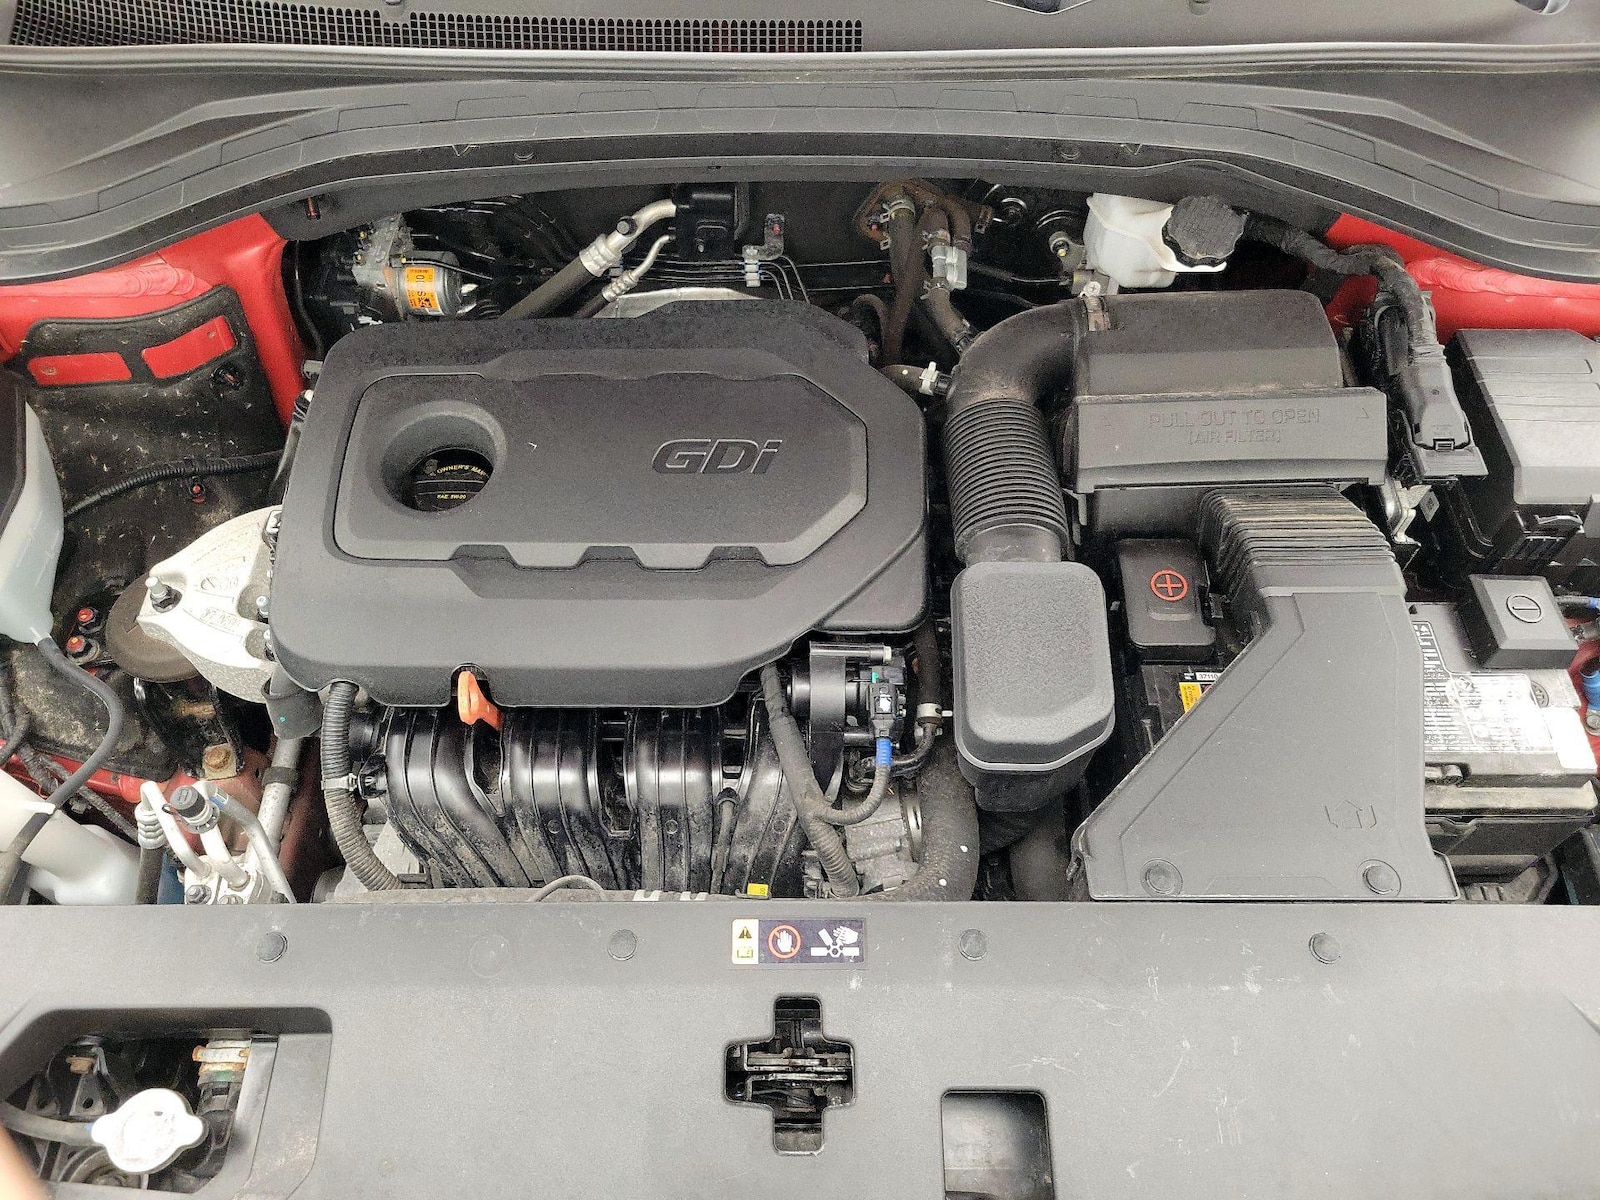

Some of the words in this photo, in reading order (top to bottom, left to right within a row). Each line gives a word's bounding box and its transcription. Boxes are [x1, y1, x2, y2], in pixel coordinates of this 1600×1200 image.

[1149, 411, 1195, 428] PULL
[1200, 410, 1237, 427] OUT
[1243, 409, 1265, 425] TO
[1271, 408, 1321, 425] OPEN
[437, 464, 470, 474] OWNER'S
